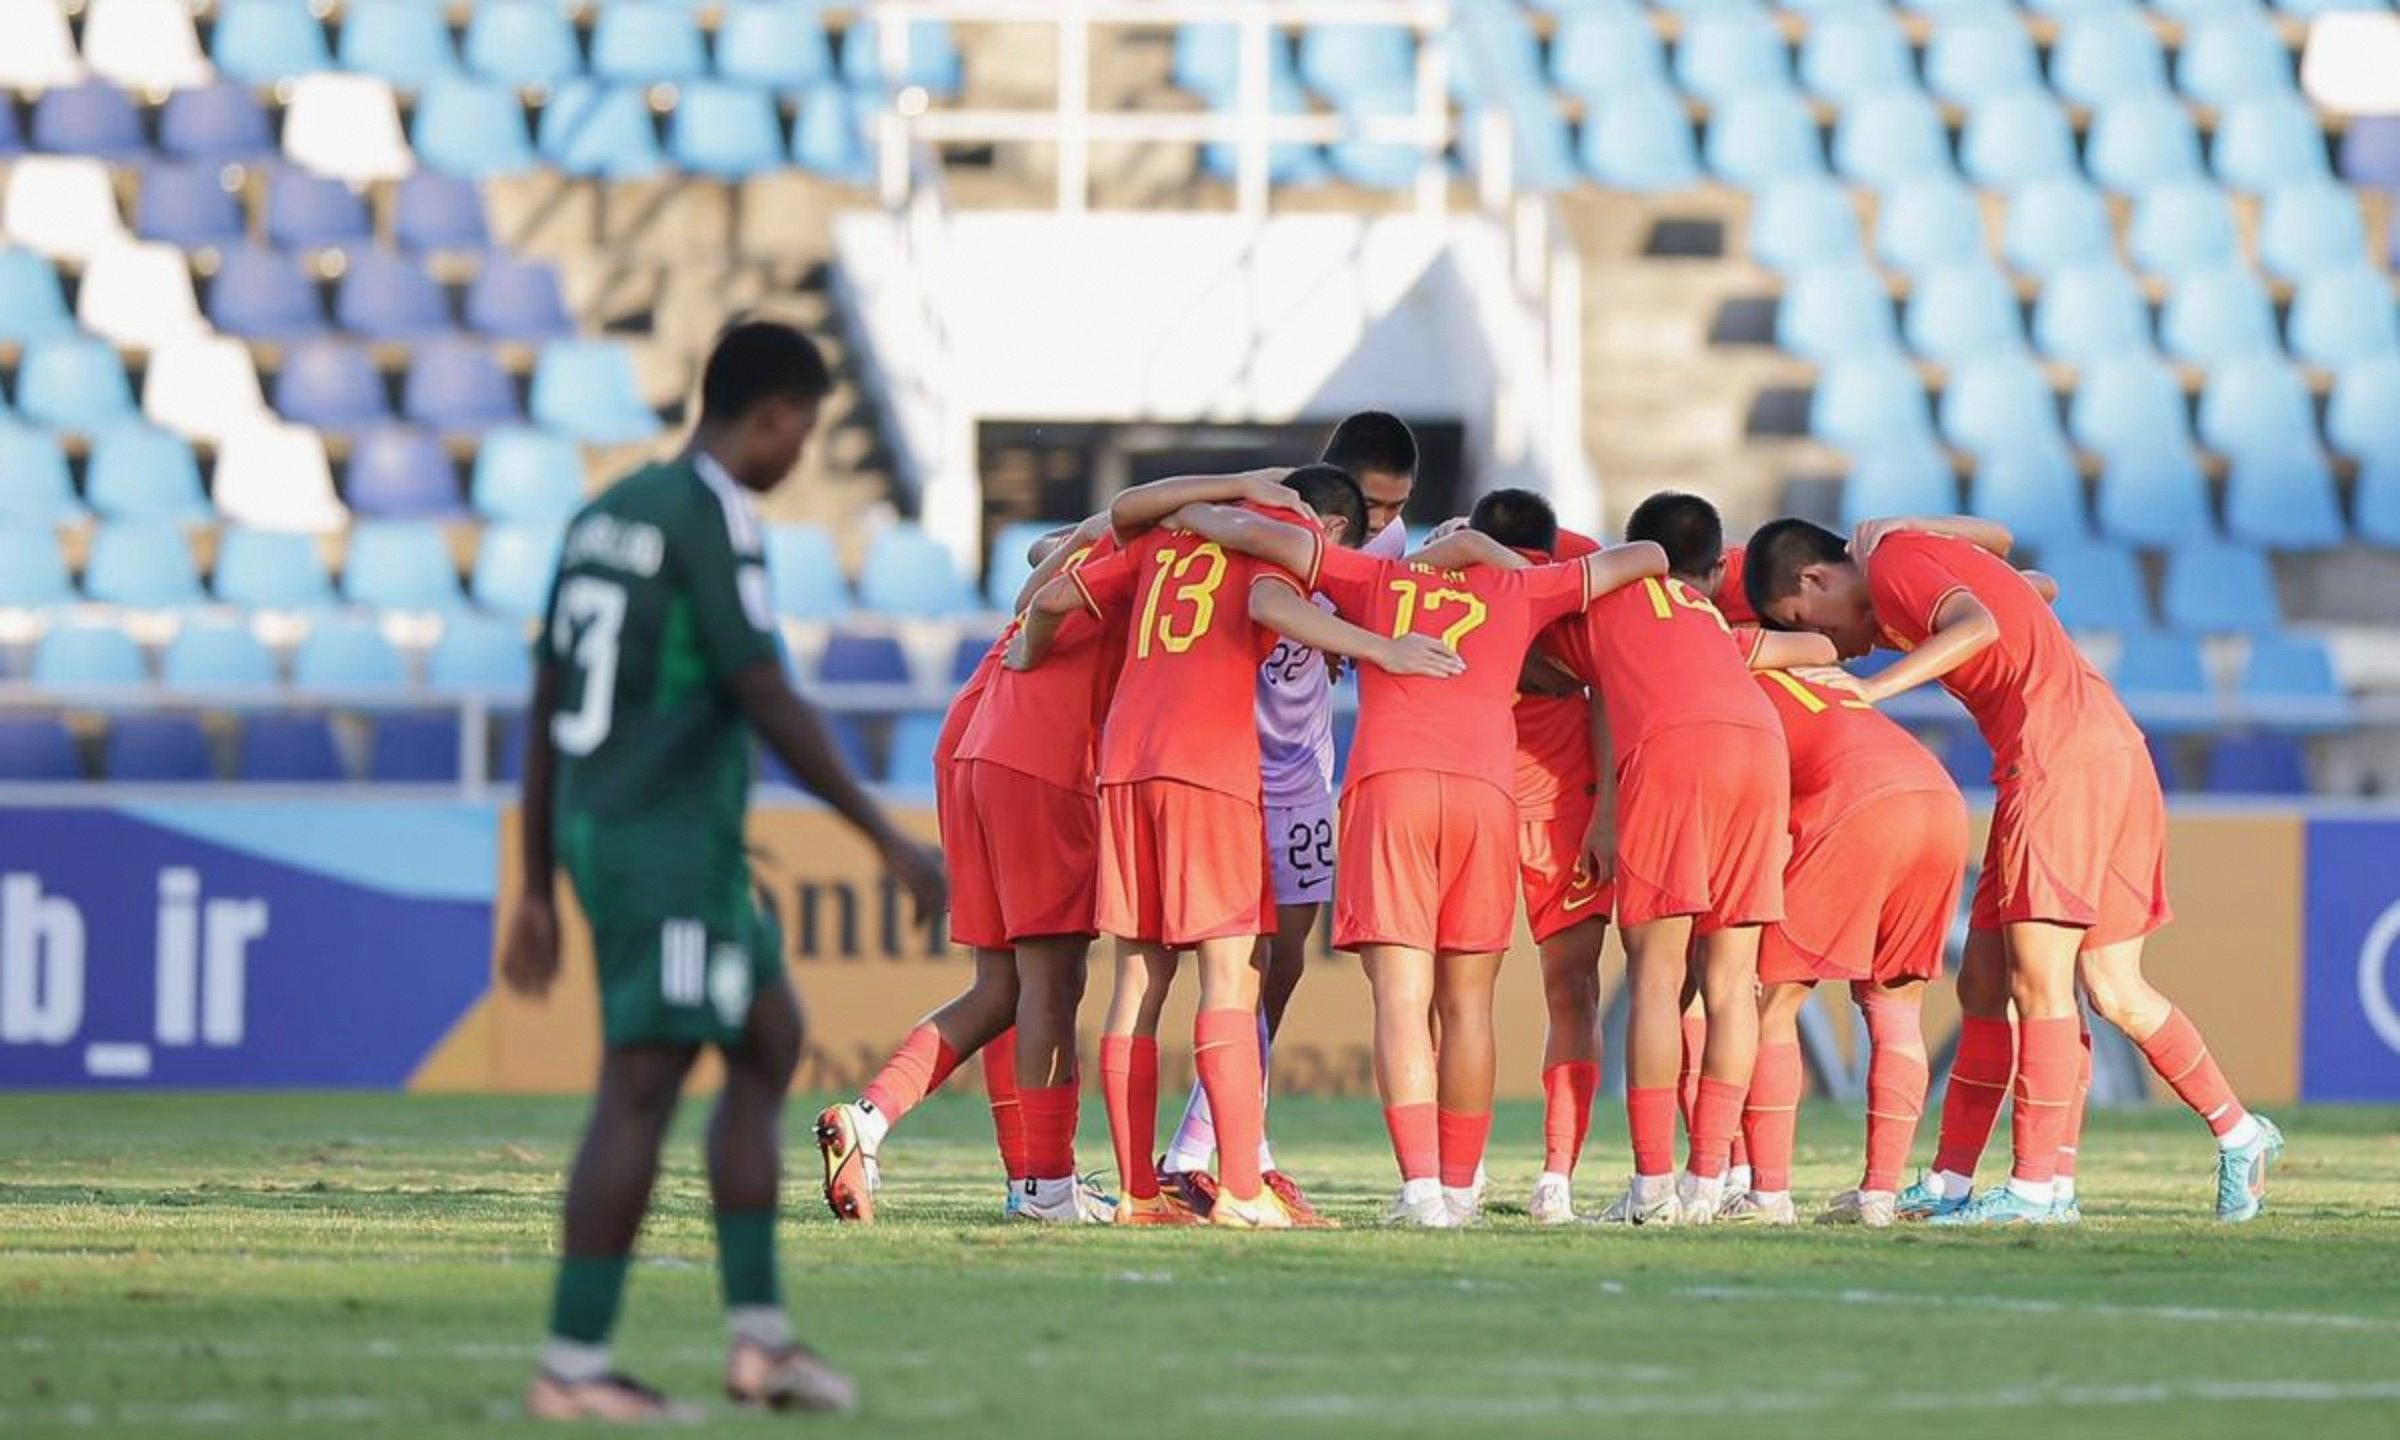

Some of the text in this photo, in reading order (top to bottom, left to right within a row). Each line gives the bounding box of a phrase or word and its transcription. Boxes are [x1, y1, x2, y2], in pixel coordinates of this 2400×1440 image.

[1138, 543, 1227, 659] 13
[1265, 643, 1312, 685] 22
[1289, 818, 1333, 870] 22
